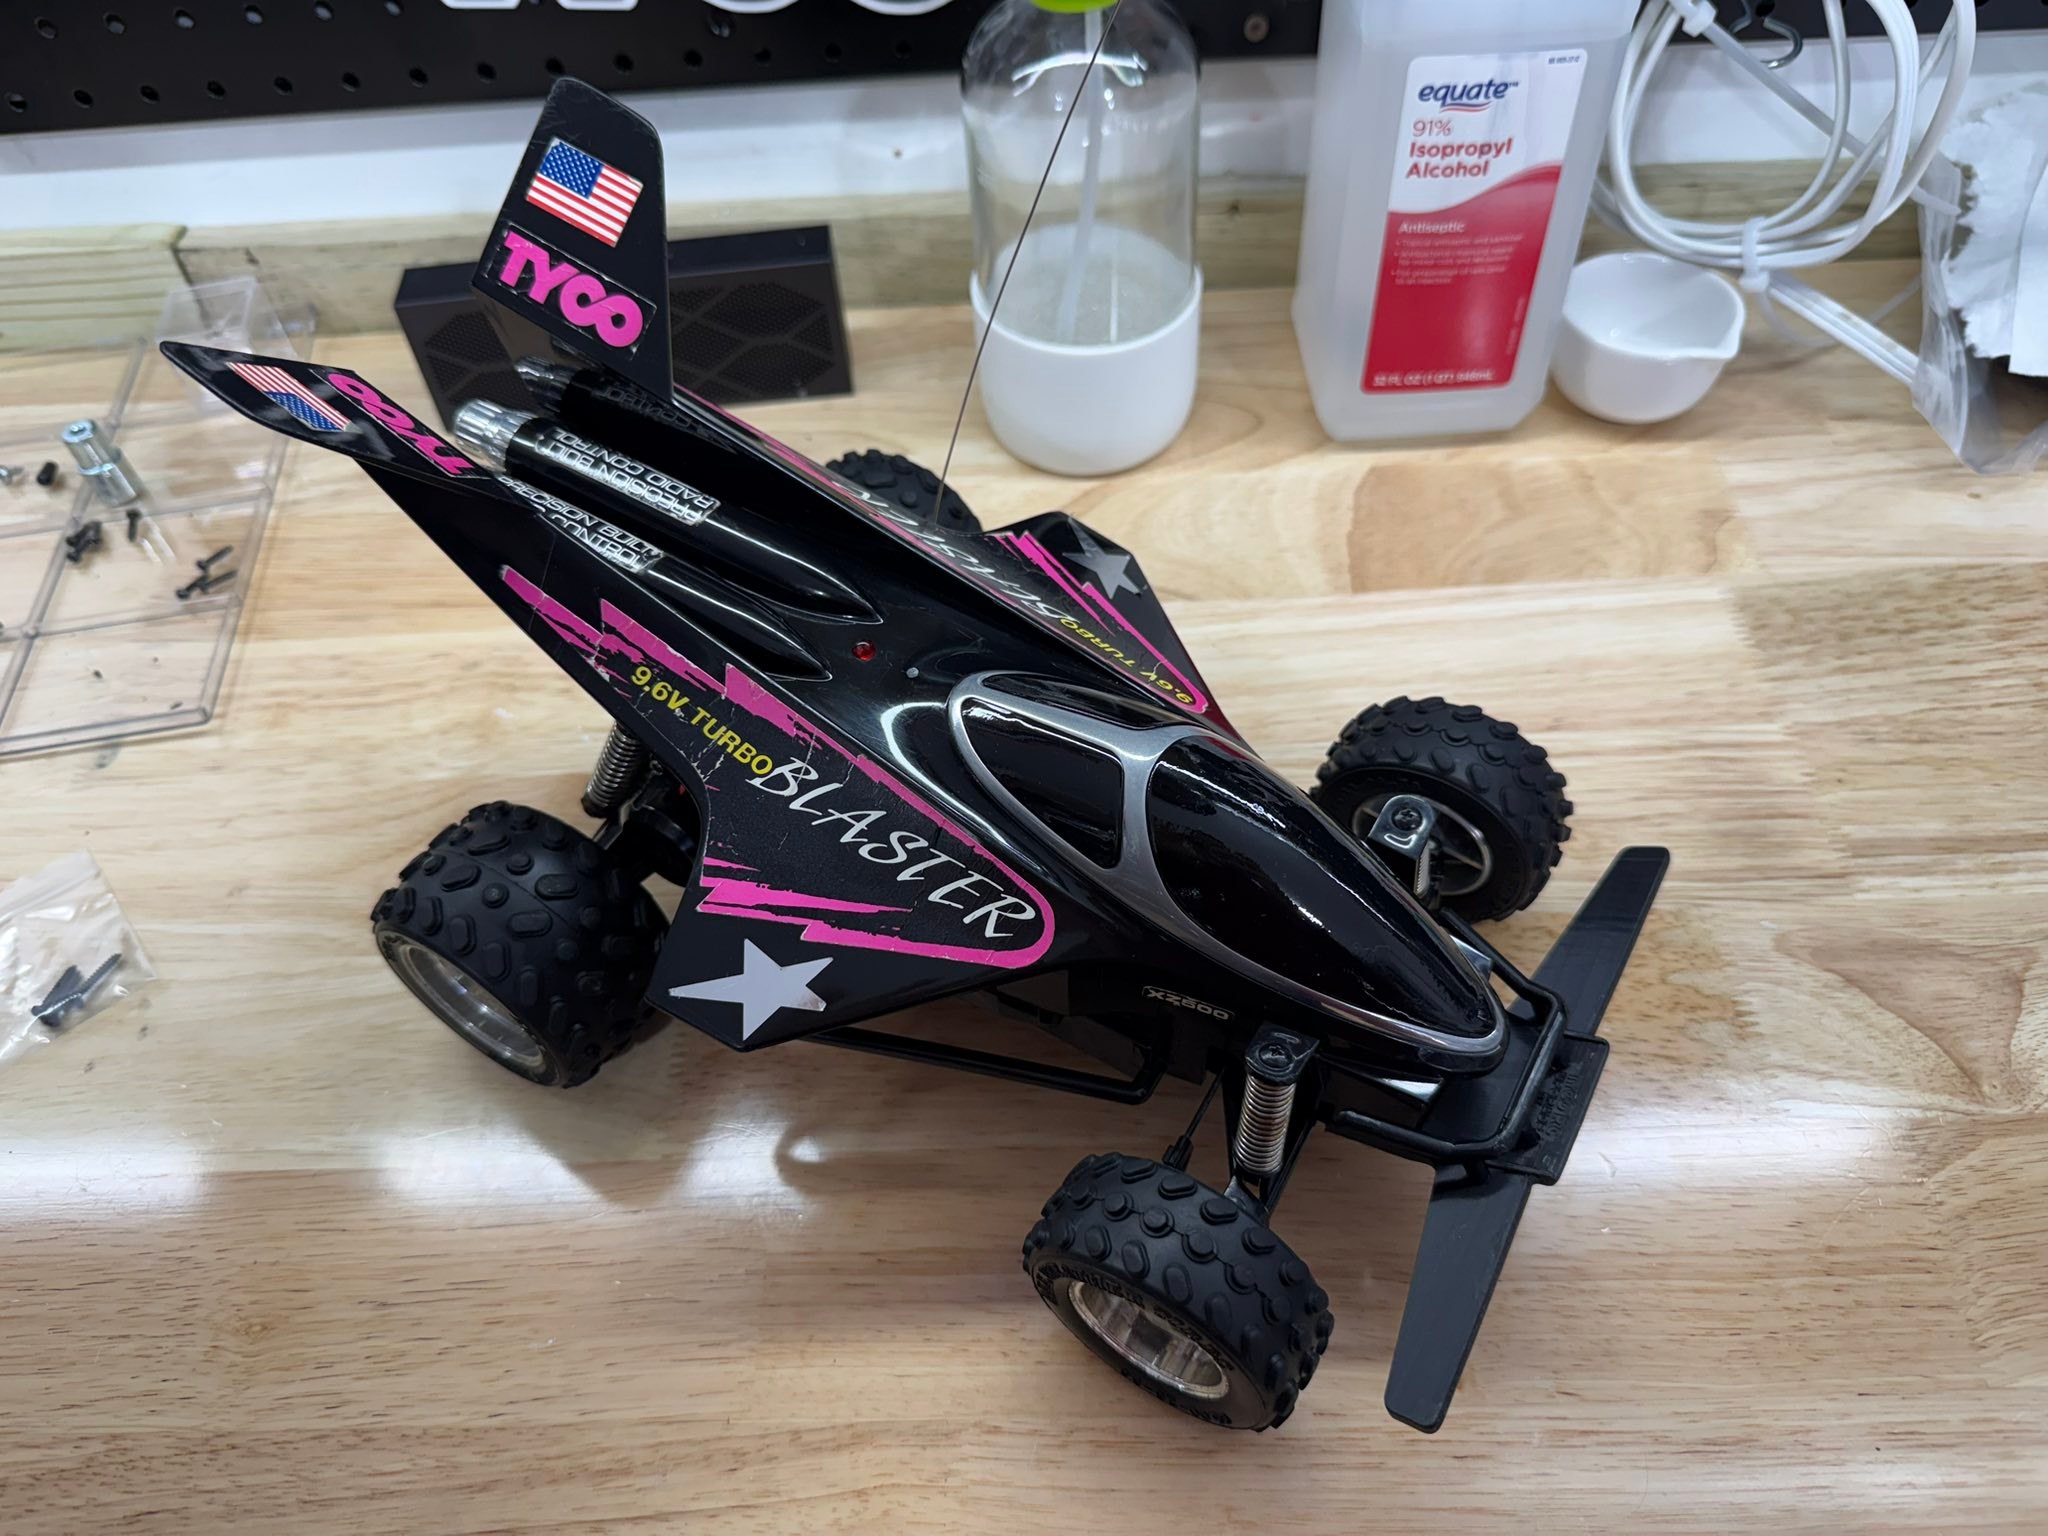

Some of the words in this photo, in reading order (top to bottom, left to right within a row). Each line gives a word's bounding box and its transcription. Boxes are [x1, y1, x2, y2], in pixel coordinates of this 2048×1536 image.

[1410, 138, 1513, 160] Isopropyl
[1413, 119, 1452, 137] 91%
[1406, 160, 1489, 178] Alcohol
[1399, 221, 1465, 234] Antiseptic
[500, 230, 643, 348] TYCO
[328, 373, 475, 475] TYCO
[549, 440, 595, 470] BUILT
[552, 428, 644, 476] CONTROL
[498, 475, 598, 526] PRECISION
[599, 523, 656, 555] BUILT
[596, 463, 704, 523] PRECISION
[647, 473, 716, 510] RADIO
[832, 481, 1081, 624] BLASTER
[1060, 618, 1136, 668] TURBO
[1139, 670, 1193, 704] 9.6V
[630, 665, 690, 711] 9.6V
[690, 706, 773, 776] TURBO
[745, 756, 1036, 938] BLASTER
